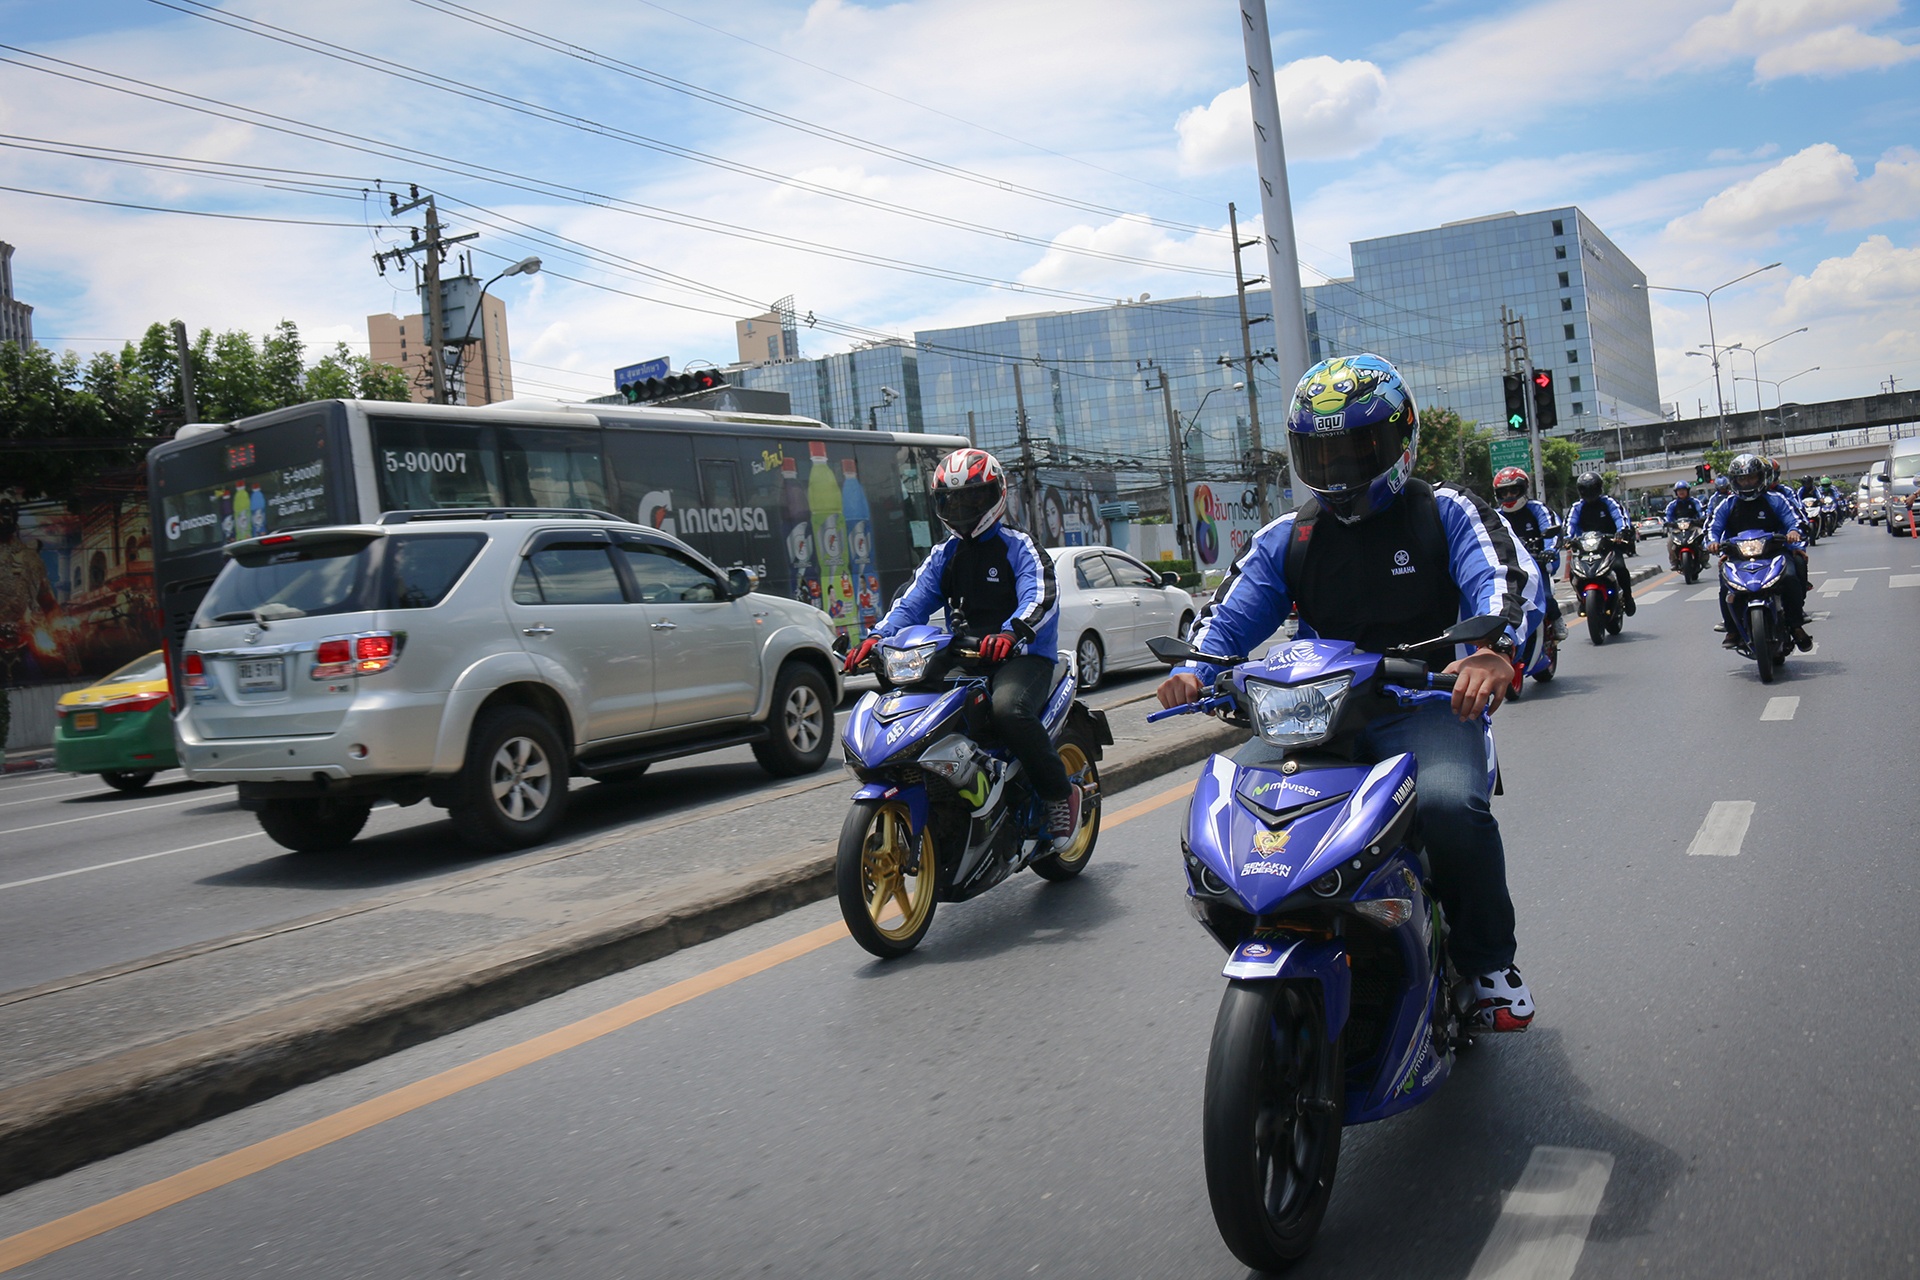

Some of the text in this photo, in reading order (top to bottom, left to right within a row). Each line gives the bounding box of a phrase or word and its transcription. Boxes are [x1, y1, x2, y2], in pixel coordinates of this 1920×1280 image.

[1317, 415, 1340, 430] agv
[385, 451, 467, 473] 5-90007
[678, 507, 769, 534] เกเตอเรด
[1391, 565, 1416, 576] YAMAHA
[886, 722, 905, 745] 46
[1269, 781, 1321, 798] movistar
[1391, 776, 1415, 806] YAMAHA
[1243, 861, 1293, 871] SEMAKIN
